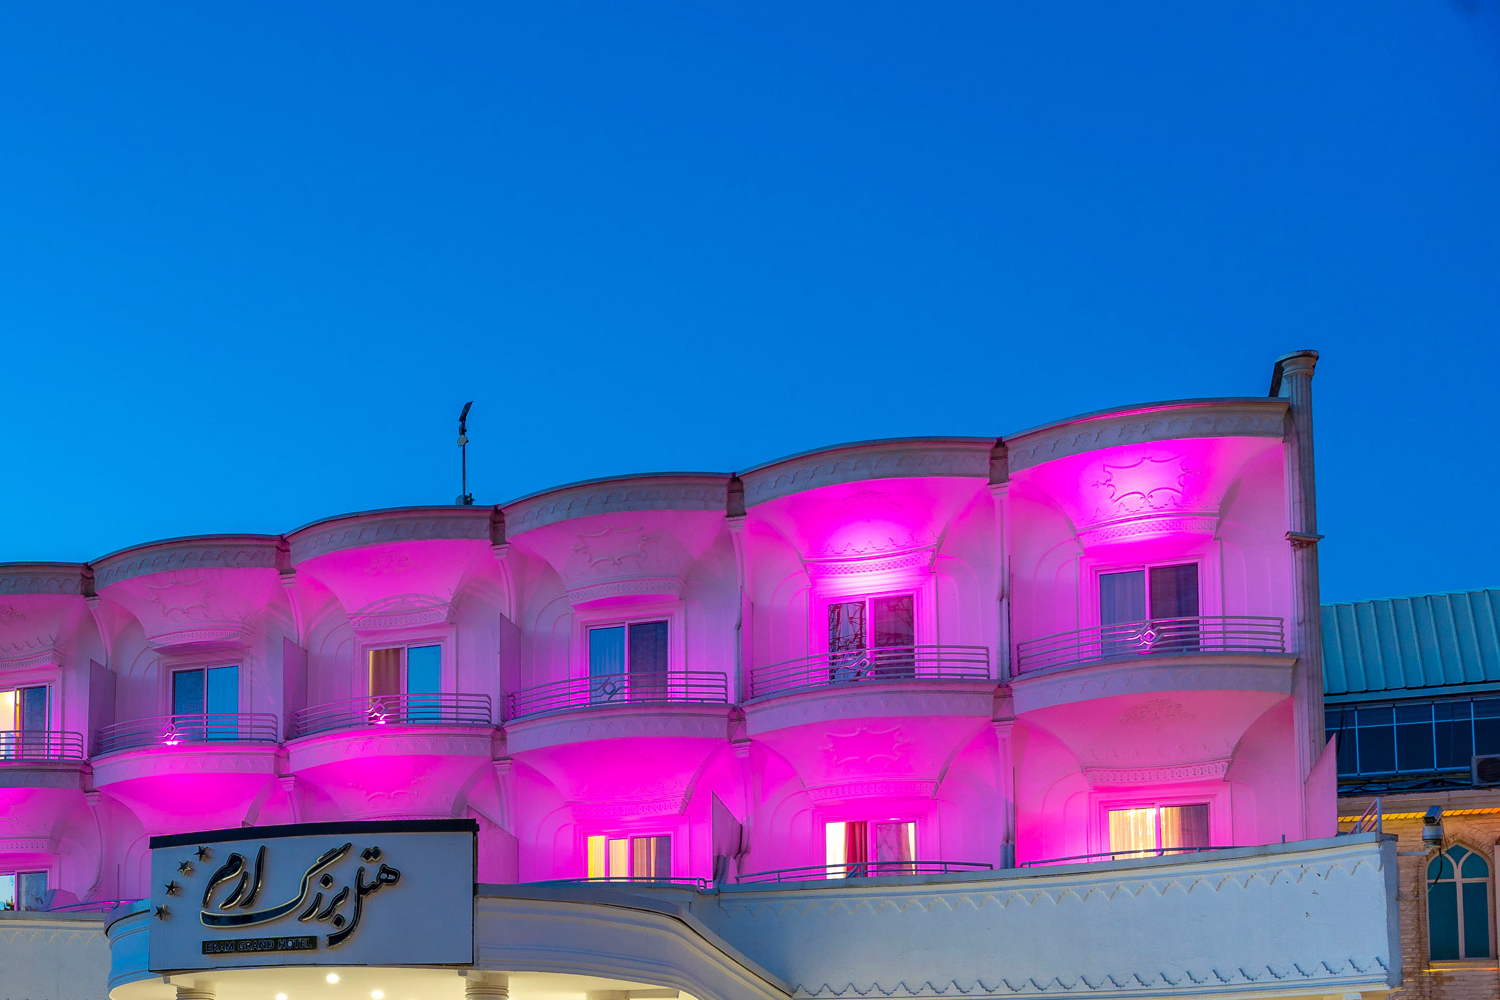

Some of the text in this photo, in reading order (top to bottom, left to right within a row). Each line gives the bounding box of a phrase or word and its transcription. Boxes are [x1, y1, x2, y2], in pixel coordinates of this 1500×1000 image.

[200, 842, 400, 948] هتل بزرگ ارم
[205, 938, 312, 953] ERAM GRAND HOTEL
